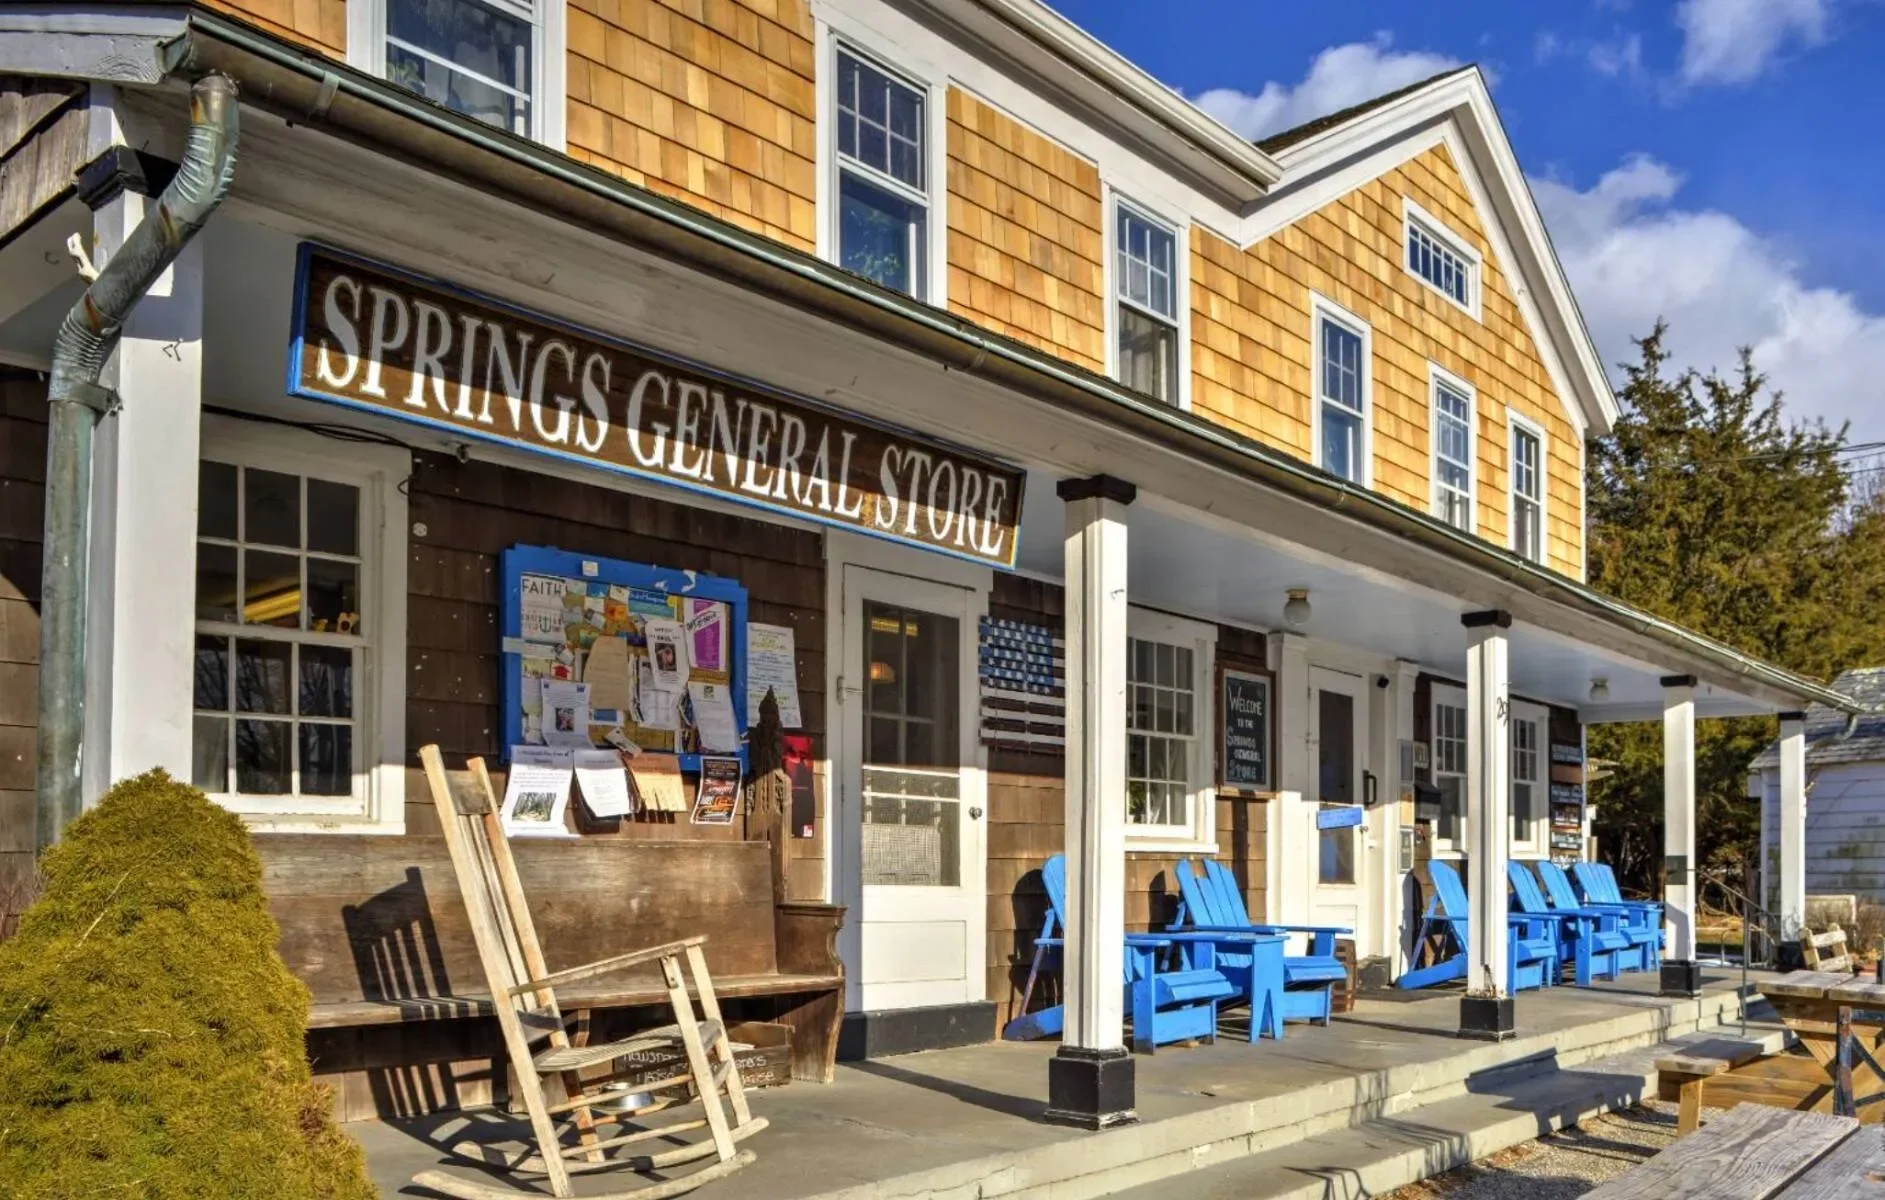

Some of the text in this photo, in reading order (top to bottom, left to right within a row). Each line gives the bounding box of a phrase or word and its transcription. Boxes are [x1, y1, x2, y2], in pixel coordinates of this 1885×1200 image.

[316, 275, 1007, 557] SPRINGS GENERAL STORE
